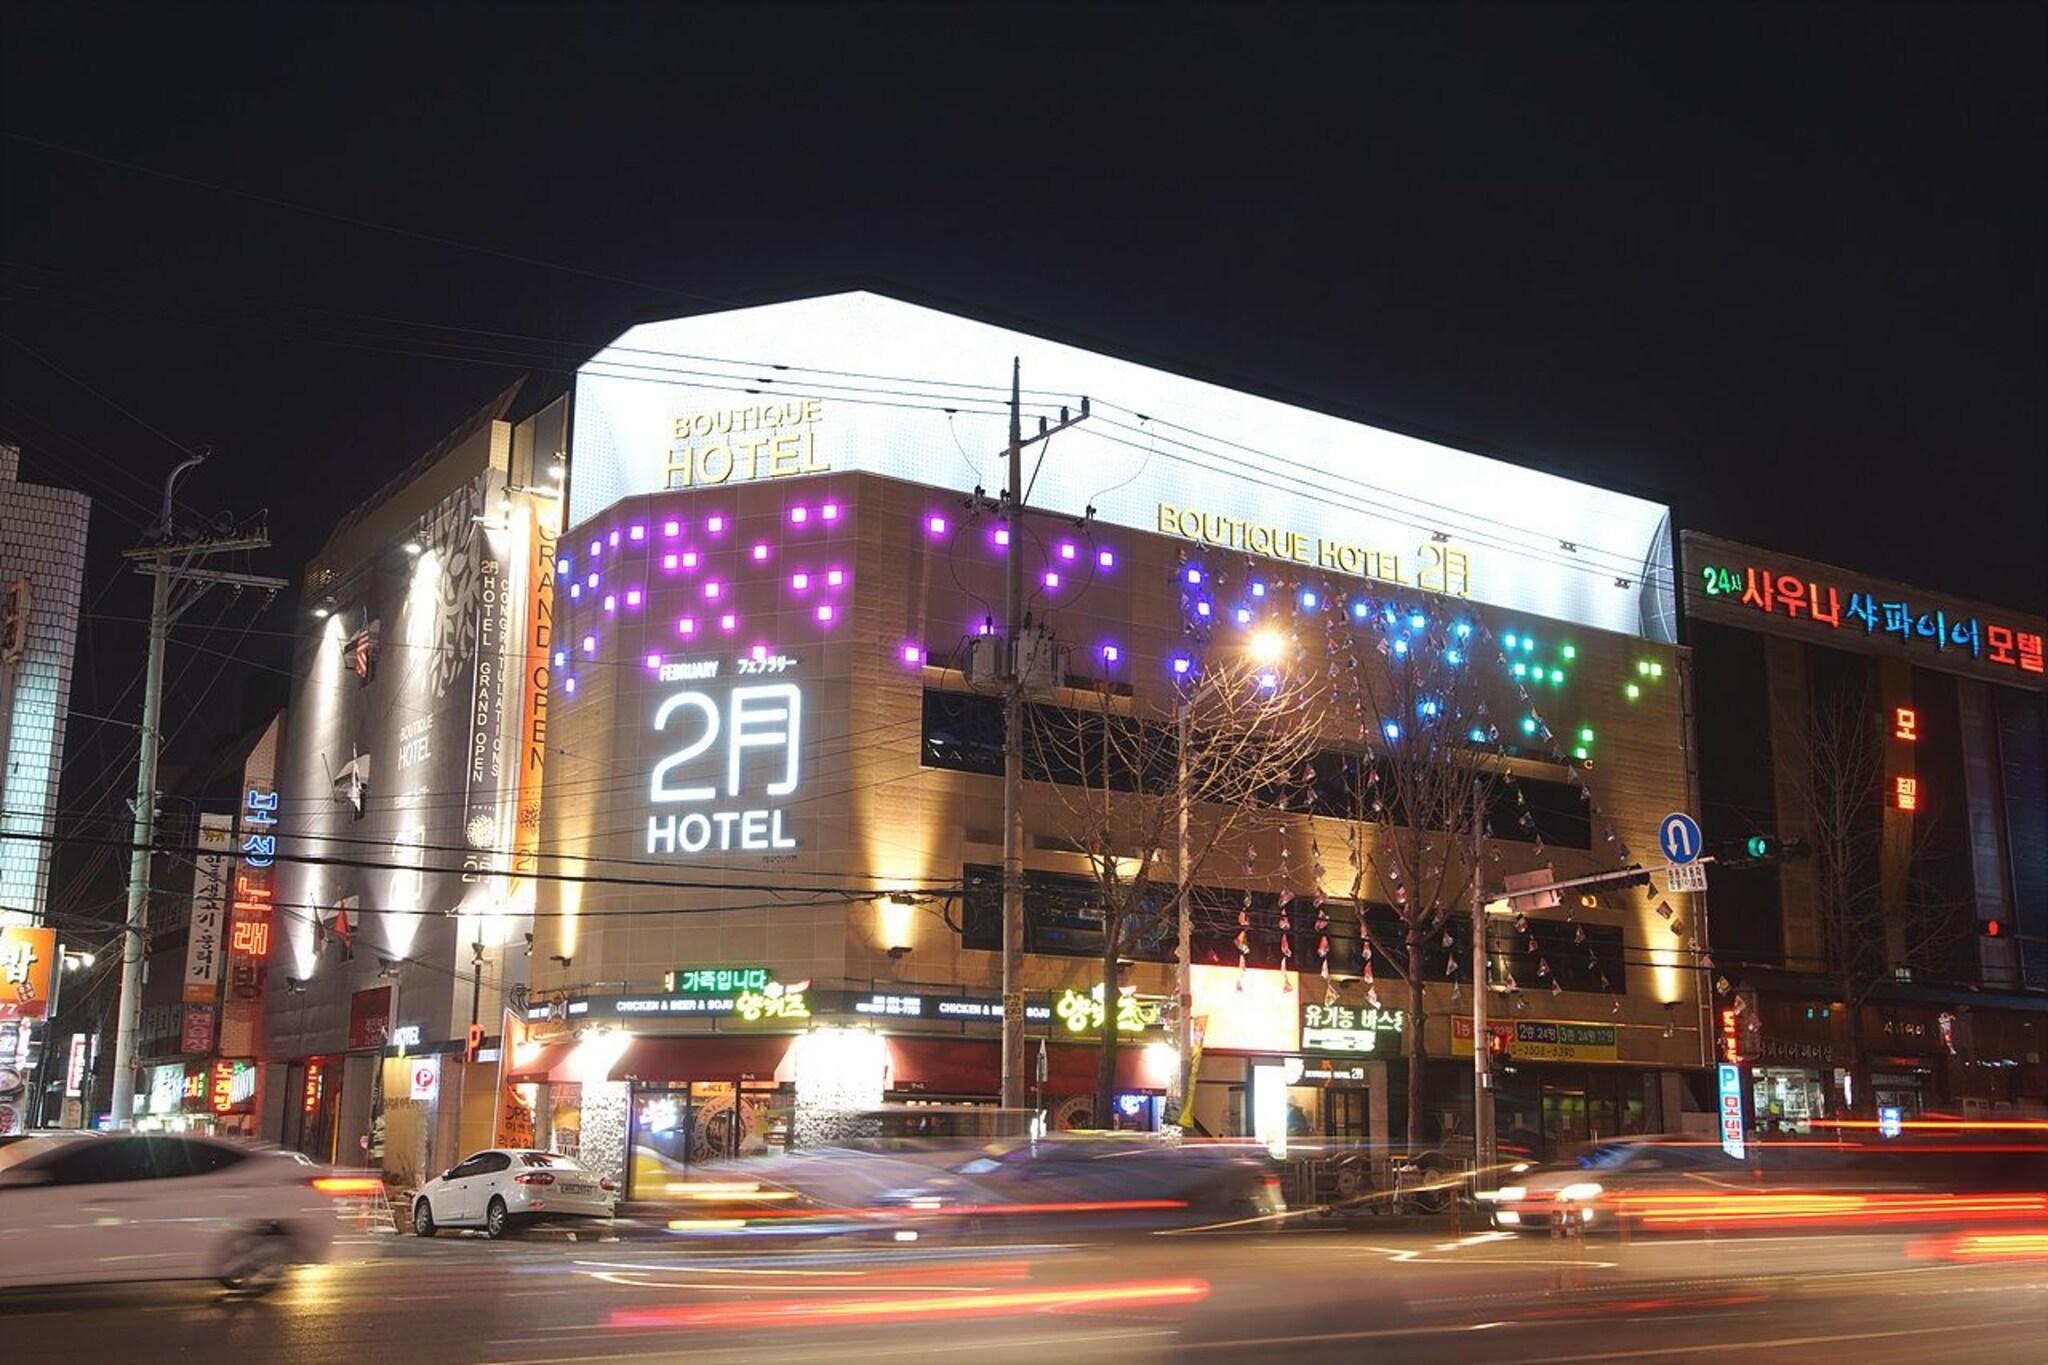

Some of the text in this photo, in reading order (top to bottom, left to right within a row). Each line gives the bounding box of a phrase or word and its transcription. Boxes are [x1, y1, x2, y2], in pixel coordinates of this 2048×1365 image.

[672, 400, 824, 440] BOUTIQUE
[663, 431, 831, 489] HOTEL
[1158, 502, 1312, 563] BOUTIQUE
[1317, 538, 1408, 585] HOTEL
[482, 577, 496, 646] HOTEL
[1742, 568, 1840, 628] 사우나
[1987, 624, 2045, 674] 모텔
[477, 662, 491, 726] GRAND
[530, 666, 550, 771] OPEN
[398, 735, 433, 771] HOTEL
[472, 732, 488, 784] OPEN
[650, 683, 802, 803] 2月
[1895, 707, 1917, 811] 모텔
[646, 809, 797, 855] HOTEL
[231, 790, 279, 1000] 보성 노래방
[616, 1000, 659, 1012] CHICKEN
[707, 999, 734, 1010] SOJU
[682, 969, 768, 992] 가족입니다
[939, 1002, 982, 1016] CHICKEN
[1026, 1007, 1050, 1018] SOJU
[1305, 1005, 1354, 1029] 유기농
[213, 1064, 233, 1111] 노래방
[1724, 1096, 1741, 1141] 모텔
